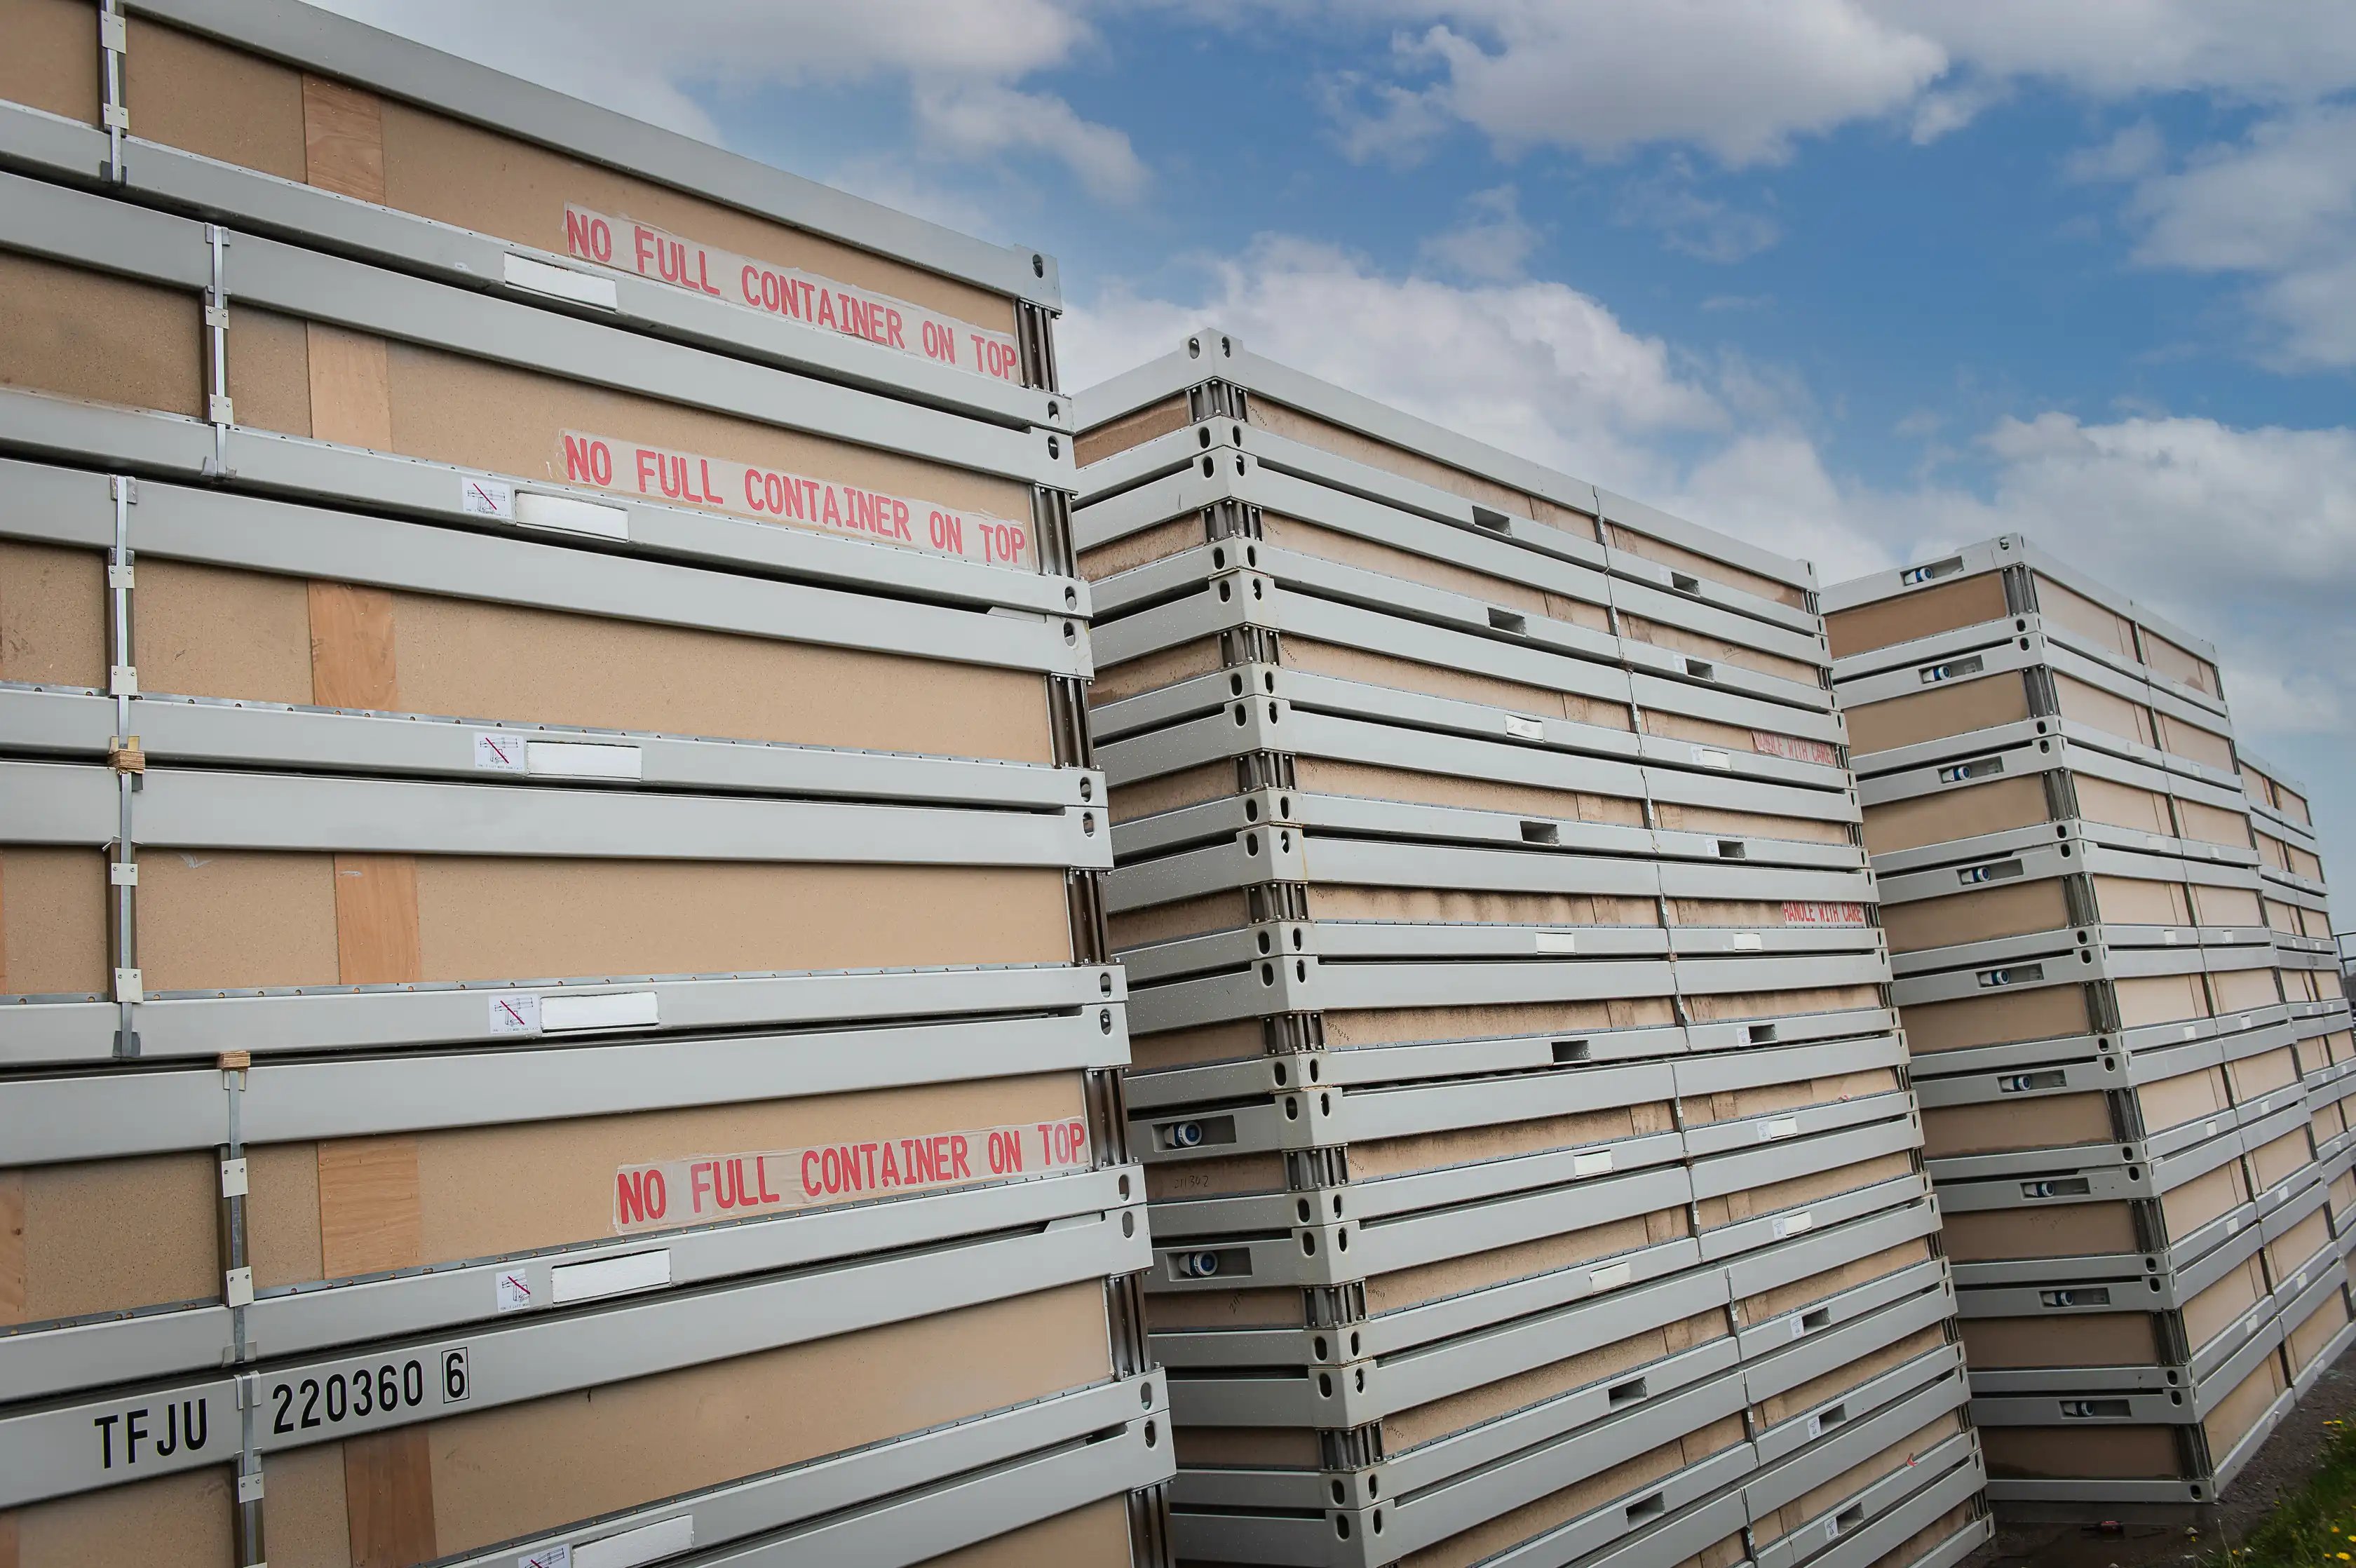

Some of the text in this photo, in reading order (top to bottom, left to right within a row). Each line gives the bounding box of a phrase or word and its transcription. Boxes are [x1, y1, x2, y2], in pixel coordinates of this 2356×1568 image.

[567, 210, 1017, 380] NO FULL CONTAINER ON TOP
[564, 434, 1026, 564] NO FULL CONTAINER ON TOP
[1787, 738, 1809, 761] WITH
[1782, 900, 1863, 923] HANDLE WITH CARE
[617, 1122, 1085, 1225] NO FULL CONTAINER ON TOP
[93, 1352, 466, 1470] TFJU 220360 6
